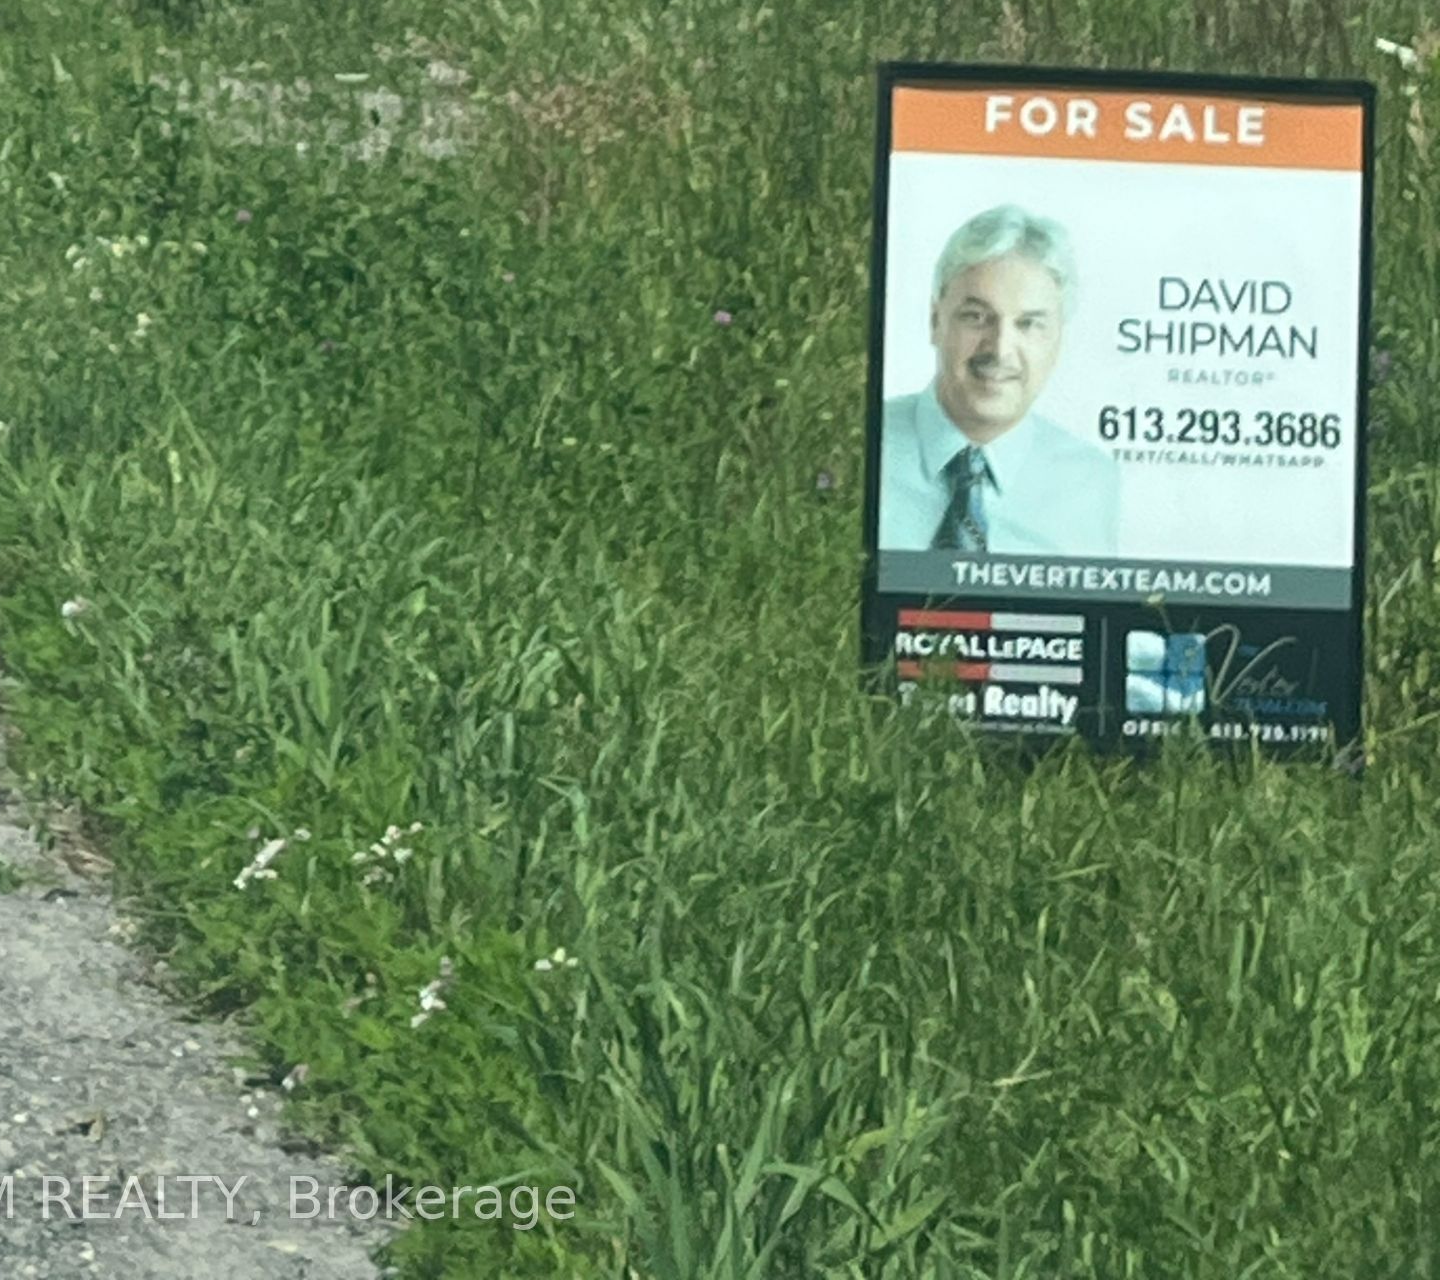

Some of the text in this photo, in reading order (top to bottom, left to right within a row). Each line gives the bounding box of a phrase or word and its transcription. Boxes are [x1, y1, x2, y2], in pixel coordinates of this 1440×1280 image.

[984, 95, 1266, 145] FOR SALE
[1159, 276, 1293, 315] DAVID
[1116, 318, 1318, 359] SHIPMAN
[1098, 404, 1342, 450] 613.293.3686
[951, 560, 1272, 595] THEVERTEXTEAM.COM
[983, 684, 1078, 725] Realty
